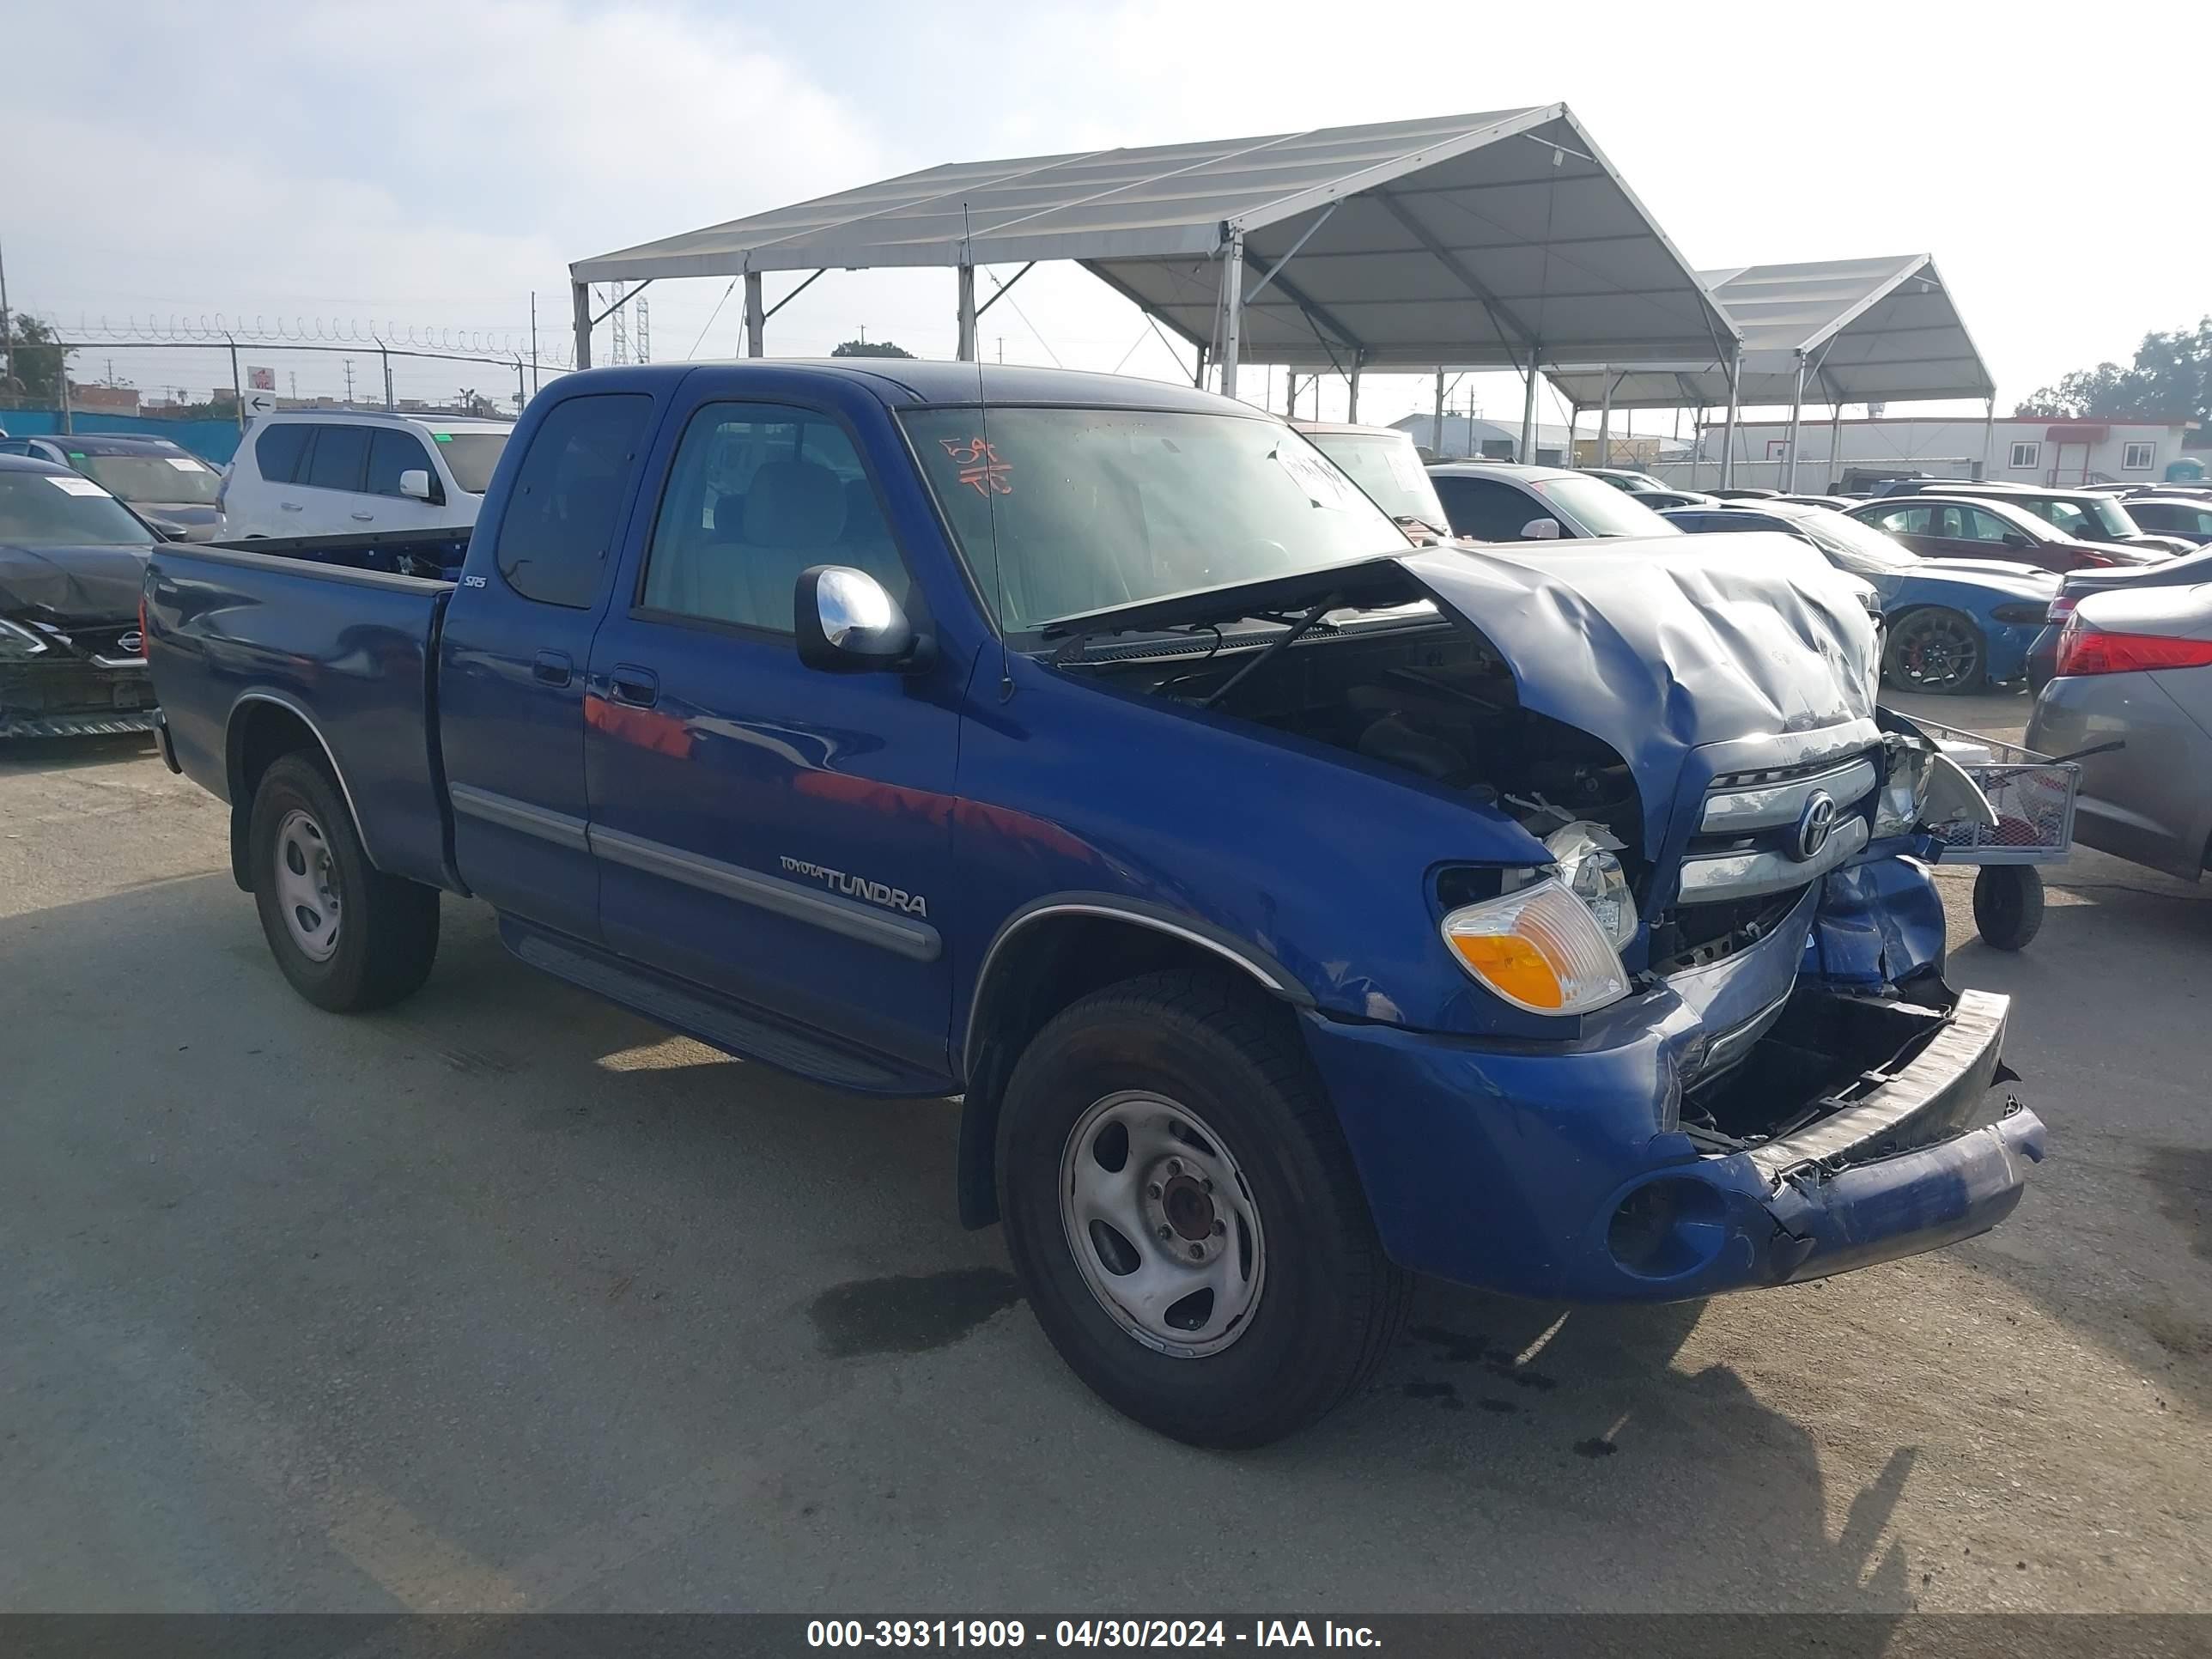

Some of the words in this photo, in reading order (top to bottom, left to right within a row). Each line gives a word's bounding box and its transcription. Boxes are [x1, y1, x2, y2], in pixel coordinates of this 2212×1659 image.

[464, 575, 487, 588] SR5
[780, 855, 824, 879] TOYOTA
[821, 867, 927, 918] TUNDRA
